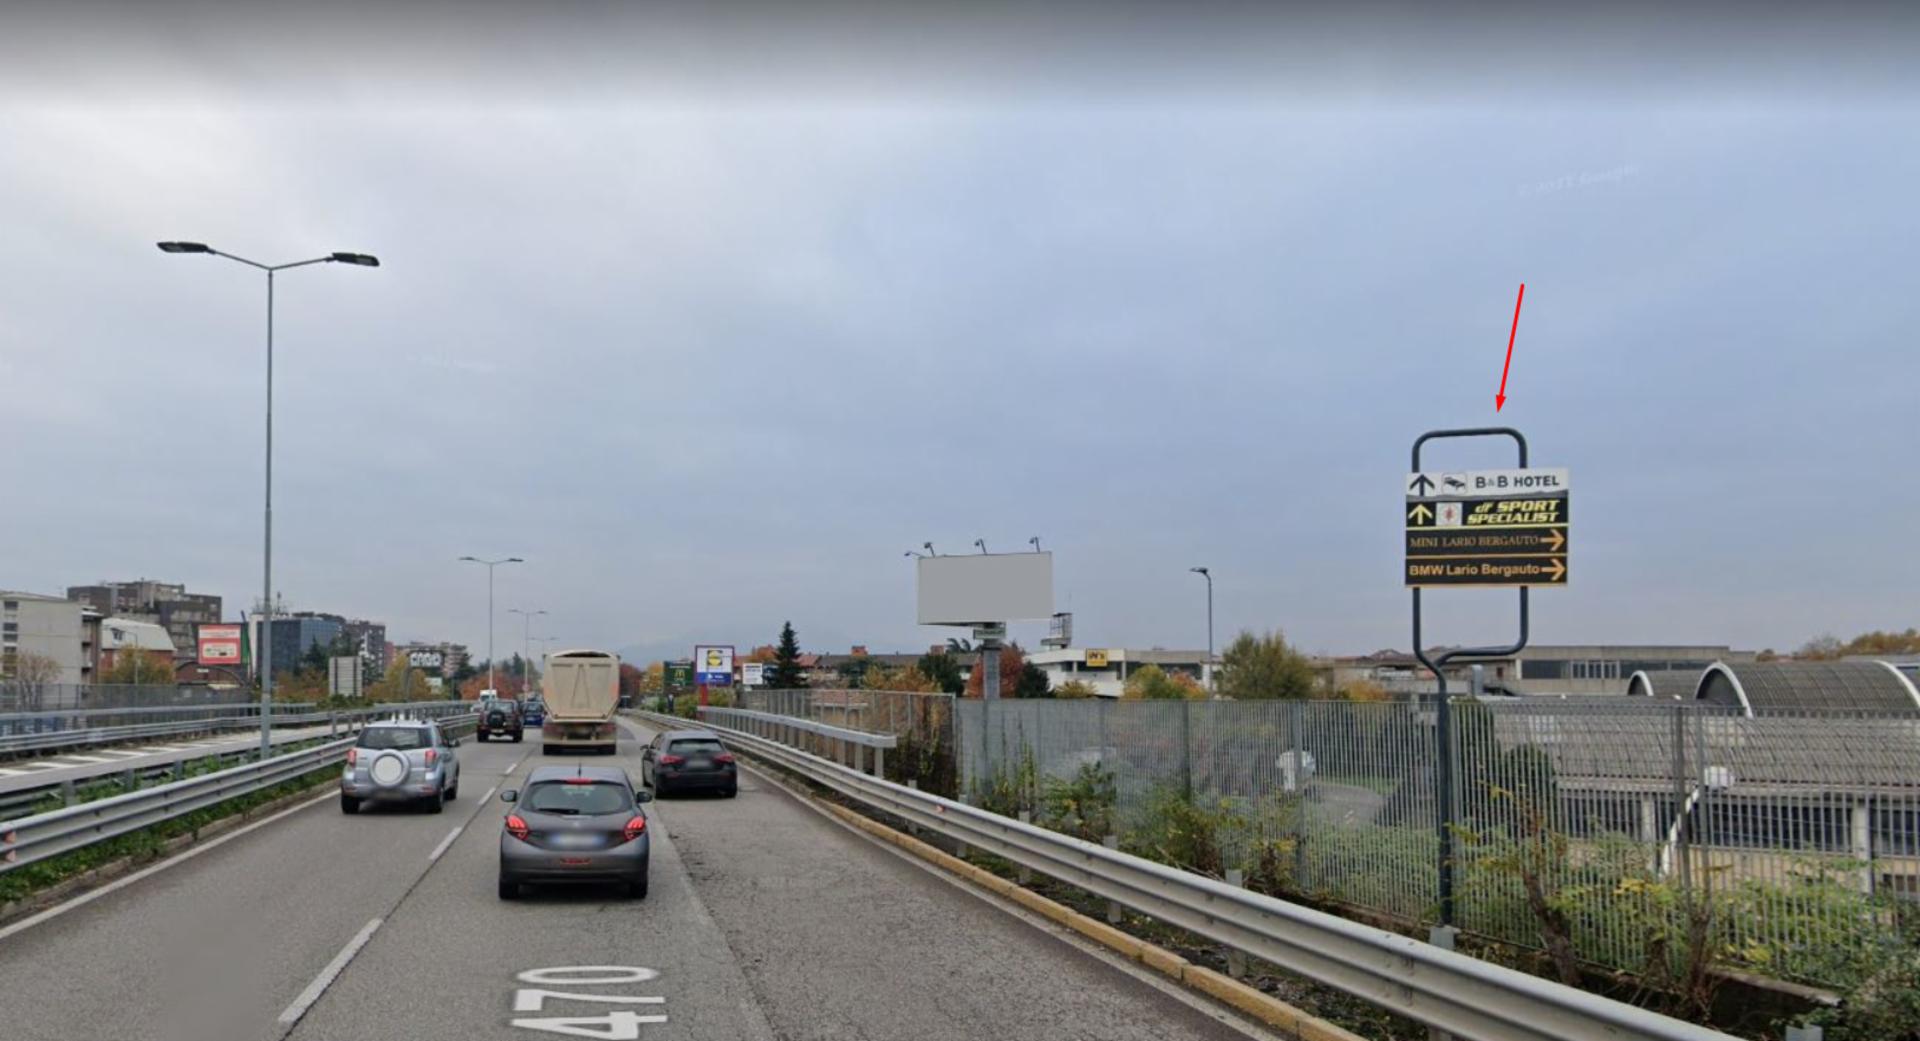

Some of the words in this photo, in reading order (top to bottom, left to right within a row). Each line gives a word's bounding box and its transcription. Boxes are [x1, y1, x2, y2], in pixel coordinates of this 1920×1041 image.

[1514, 475, 1560, 487] HOTEL
[1497, 500, 1560, 513] SPORT
[1467, 512, 1560, 525] SPECIALIST
[1410, 537, 1438, 548] MINI
[1442, 536, 1476, 547] LARIO
[1479, 535, 1538, 546] BERGAUTO
[1409, 564, 1443, 576] BMW
[1446, 563, 1478, 575] Lario
[1481, 563, 1540, 577] Bergauto
